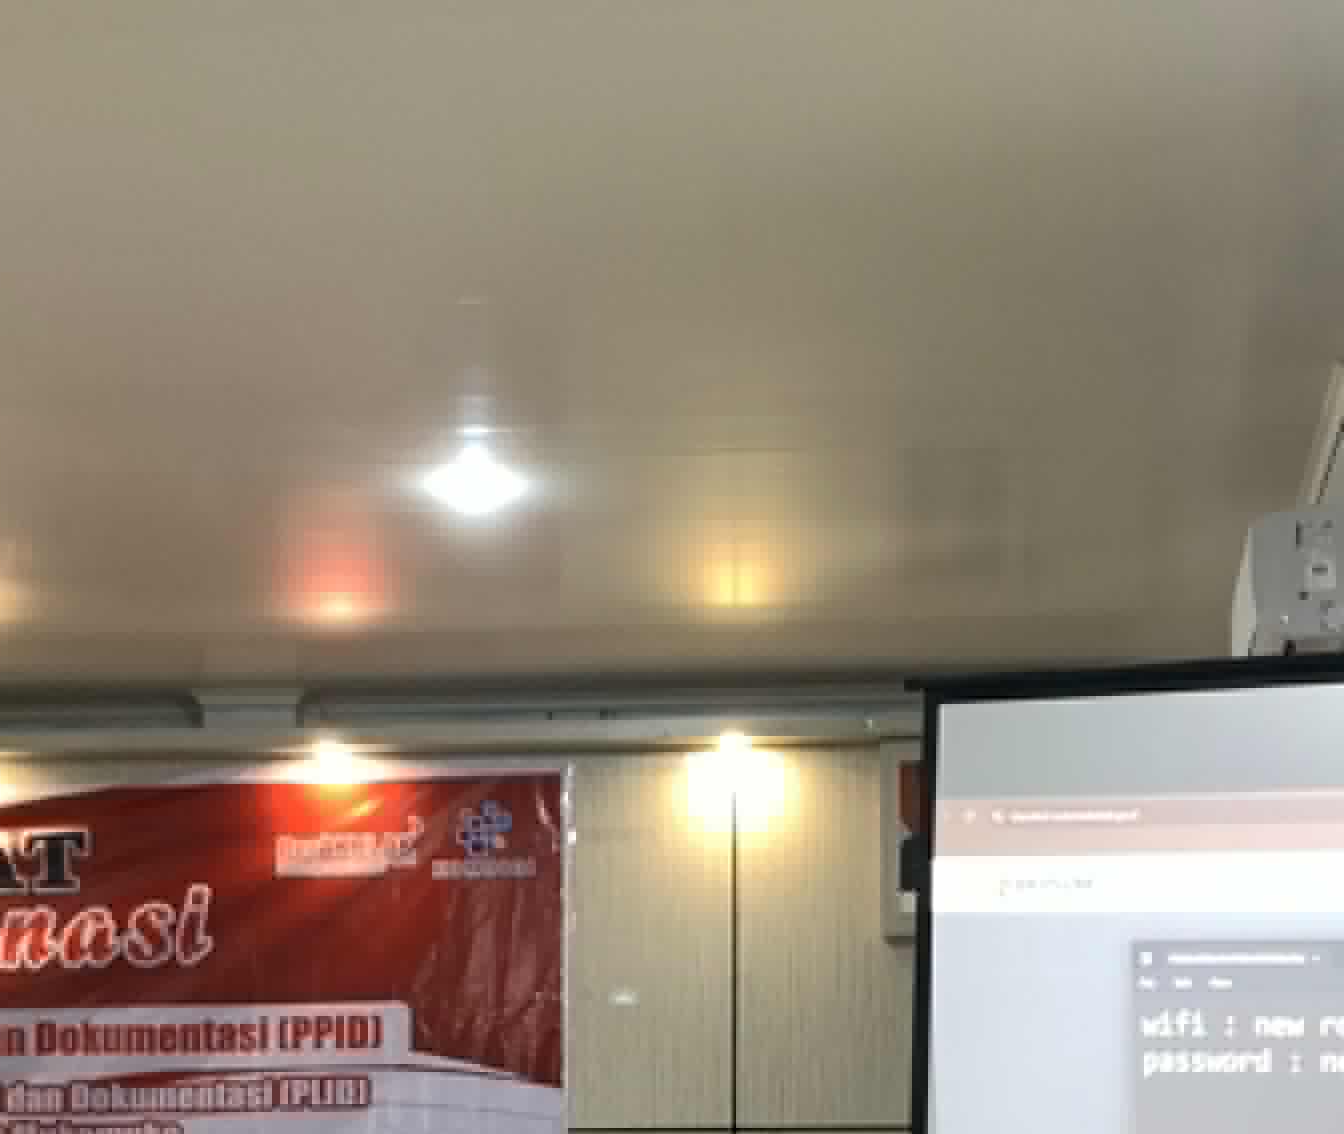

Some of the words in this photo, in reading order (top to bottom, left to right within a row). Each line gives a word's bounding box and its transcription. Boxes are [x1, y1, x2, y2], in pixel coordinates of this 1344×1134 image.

[35, 1017, 270, 1056] Dokumentasi
[277, 1014, 383, 1053] (PPID)
[1140, 1009, 1207, 1038] wifi
[1254, 1014, 1305, 1038] new
[1142, 1048, 1273, 1077] password
[8, 1081, 62, 1112] dan
[70, 1078, 271, 1112] Dokumentasi
